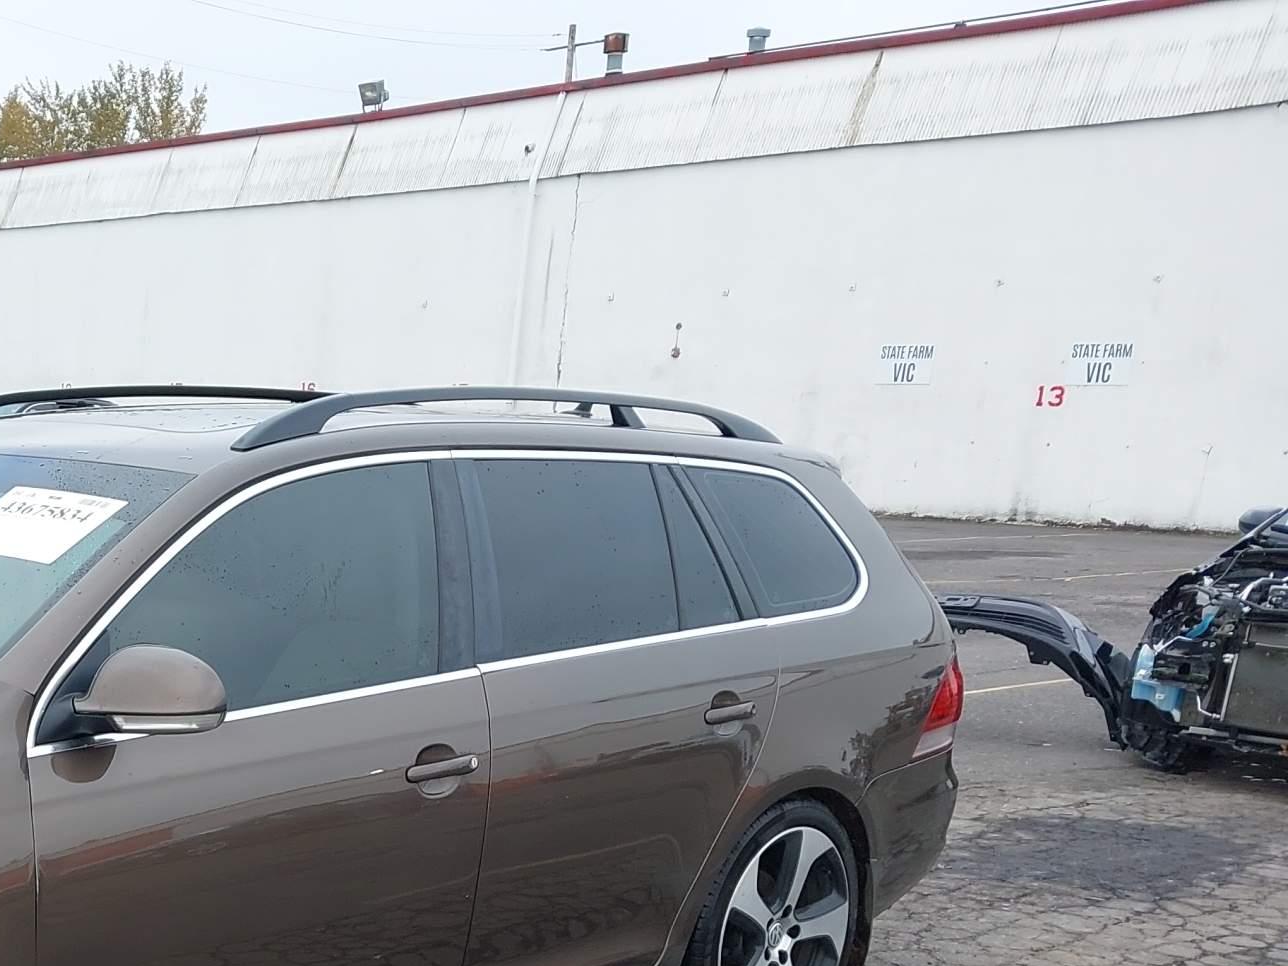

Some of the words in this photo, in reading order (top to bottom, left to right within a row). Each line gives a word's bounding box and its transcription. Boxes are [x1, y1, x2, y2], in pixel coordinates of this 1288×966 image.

[880, 345, 907, 360] STATE
[907, 345, 934, 360] FARM
[1071, 343, 1101, 358] STATE
[1102, 343, 1134, 358] FARM
[893, 362, 917, 383] VIC
[1086, 361, 1113, 384] VIC
[1035, 385, 1065, 407] 13
[0, 500, 95, 523] 43675834
